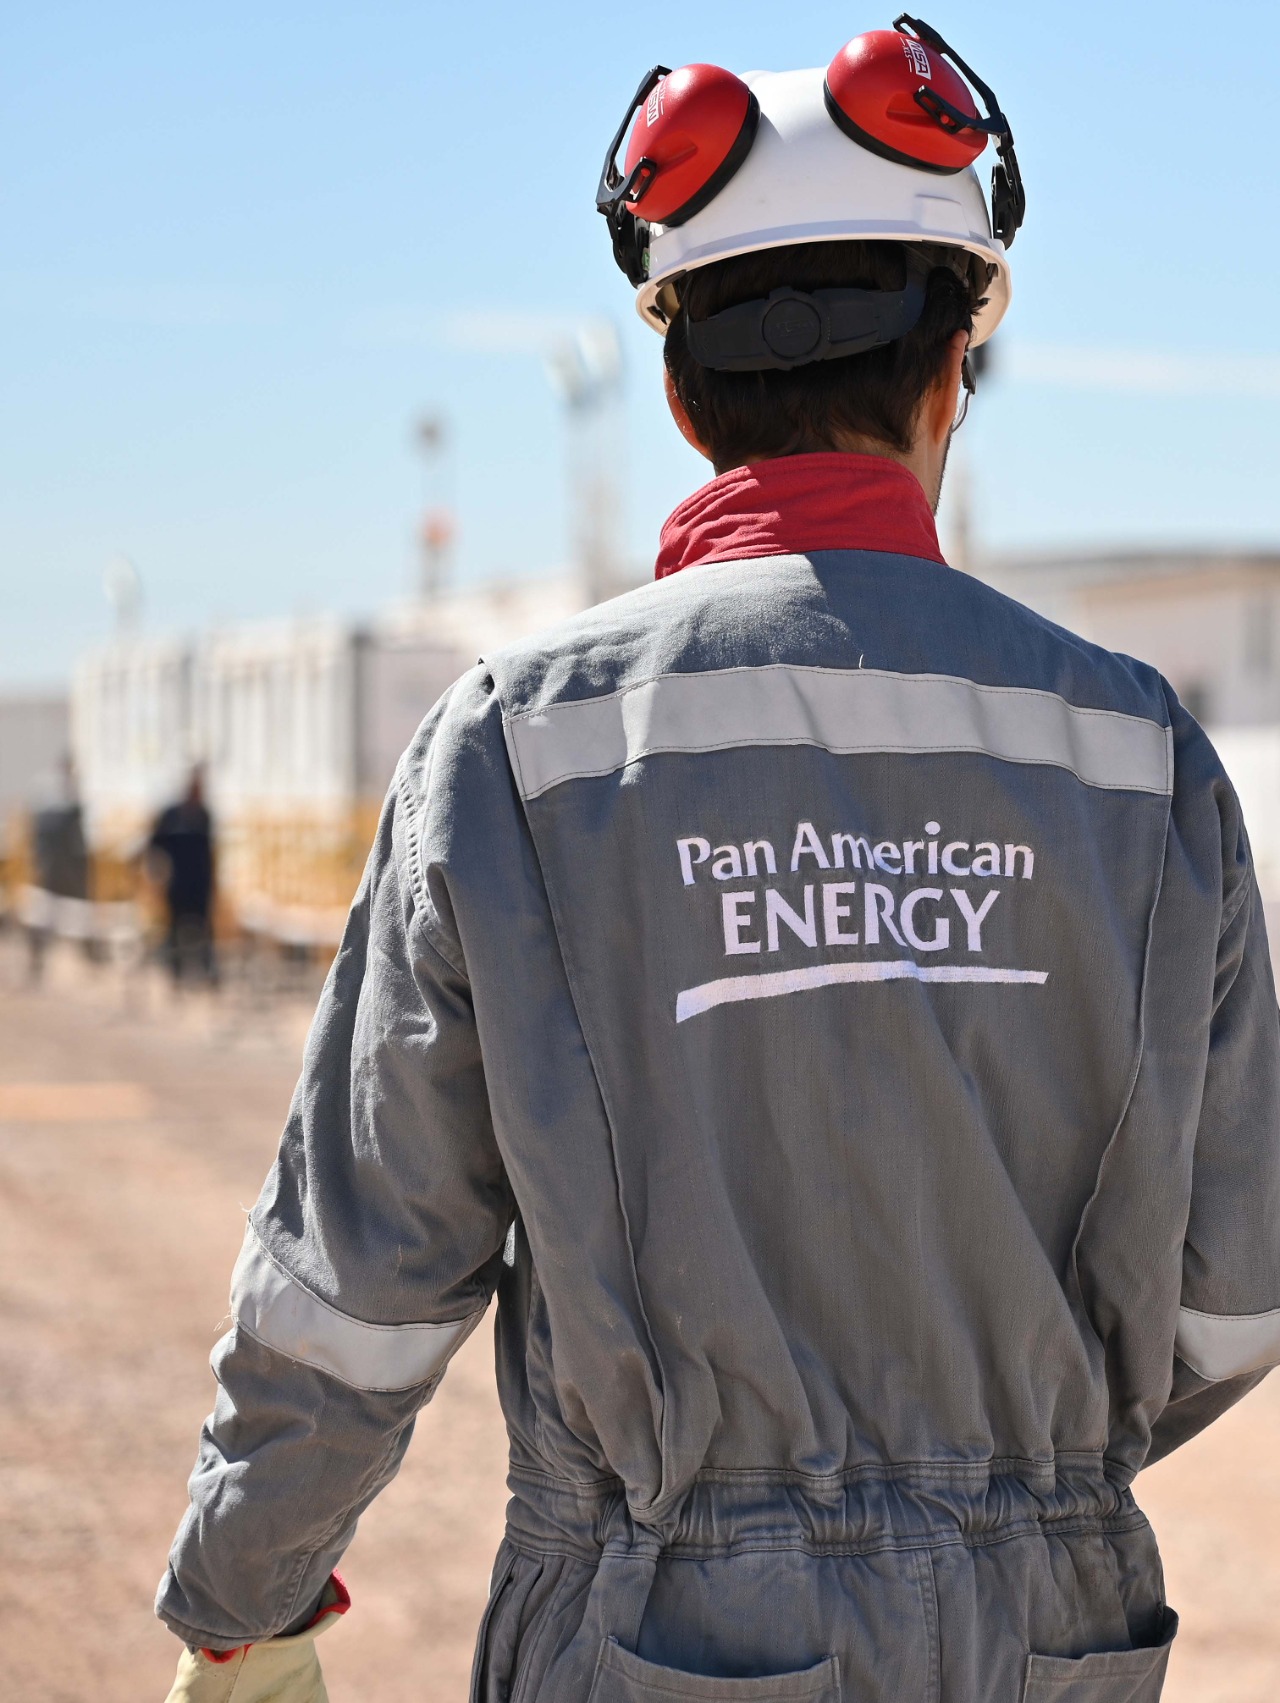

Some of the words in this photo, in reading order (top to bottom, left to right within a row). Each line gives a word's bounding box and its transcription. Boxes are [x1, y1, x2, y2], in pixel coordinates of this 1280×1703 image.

[907, 40, 929, 74] MSA
[675, 835, 777, 887] Pan
[790, 820, 1035, 880] American
[721, 881, 1001, 956] ENERGY
